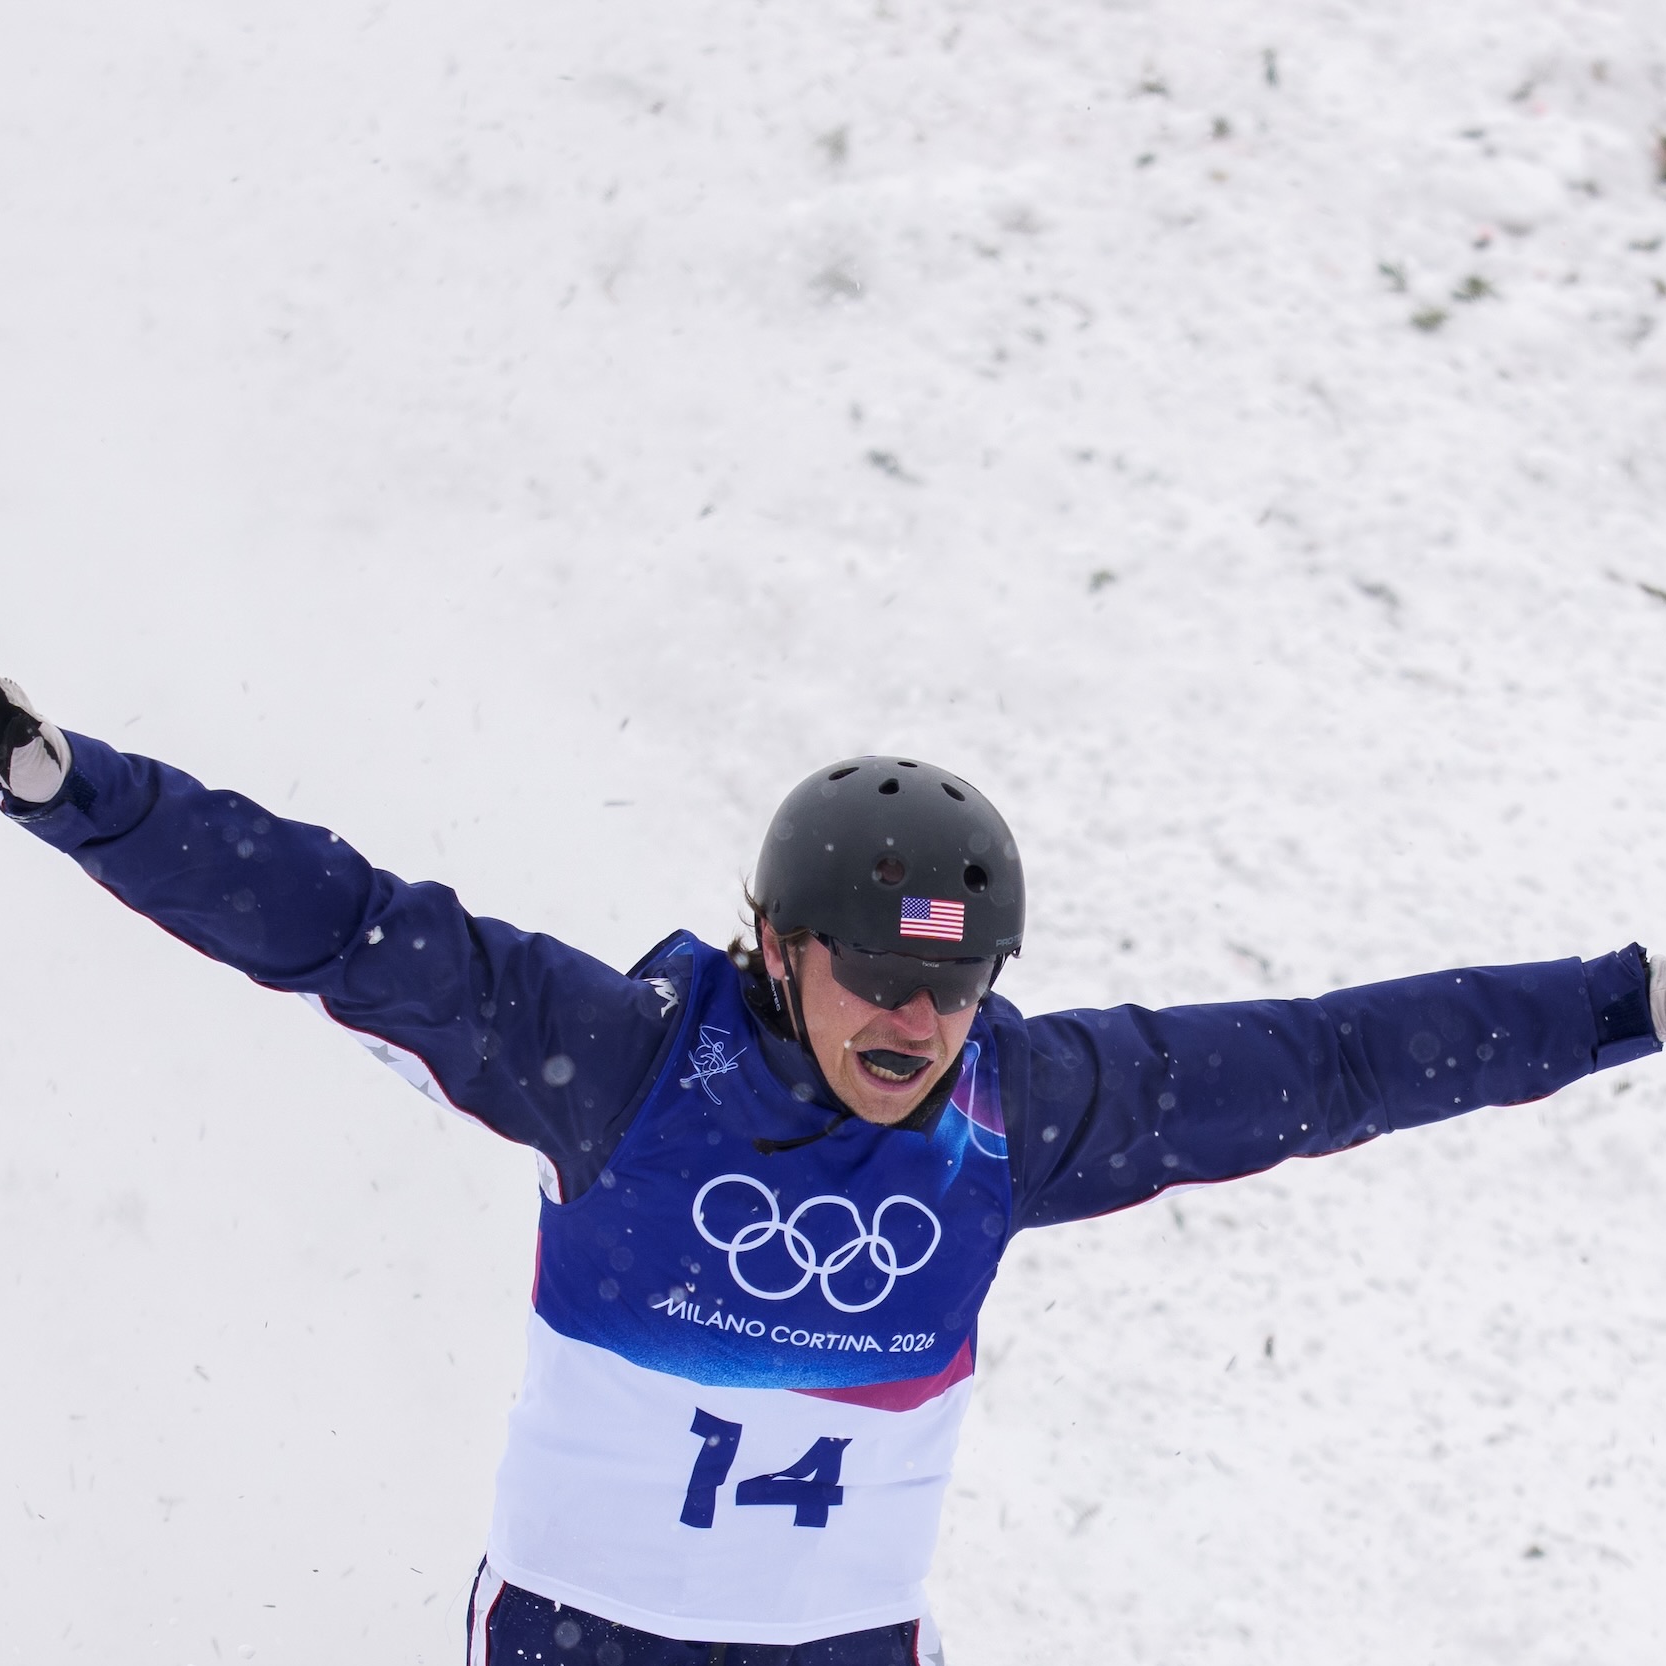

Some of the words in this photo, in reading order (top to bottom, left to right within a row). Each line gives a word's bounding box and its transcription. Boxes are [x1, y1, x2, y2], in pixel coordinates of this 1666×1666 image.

[652, 1297, 766, 1338] MILANO
[770, 1325, 883, 1353] CORTINA
[888, 1332, 936, 1353] 2026
[679, 1406, 854, 1529] 14
